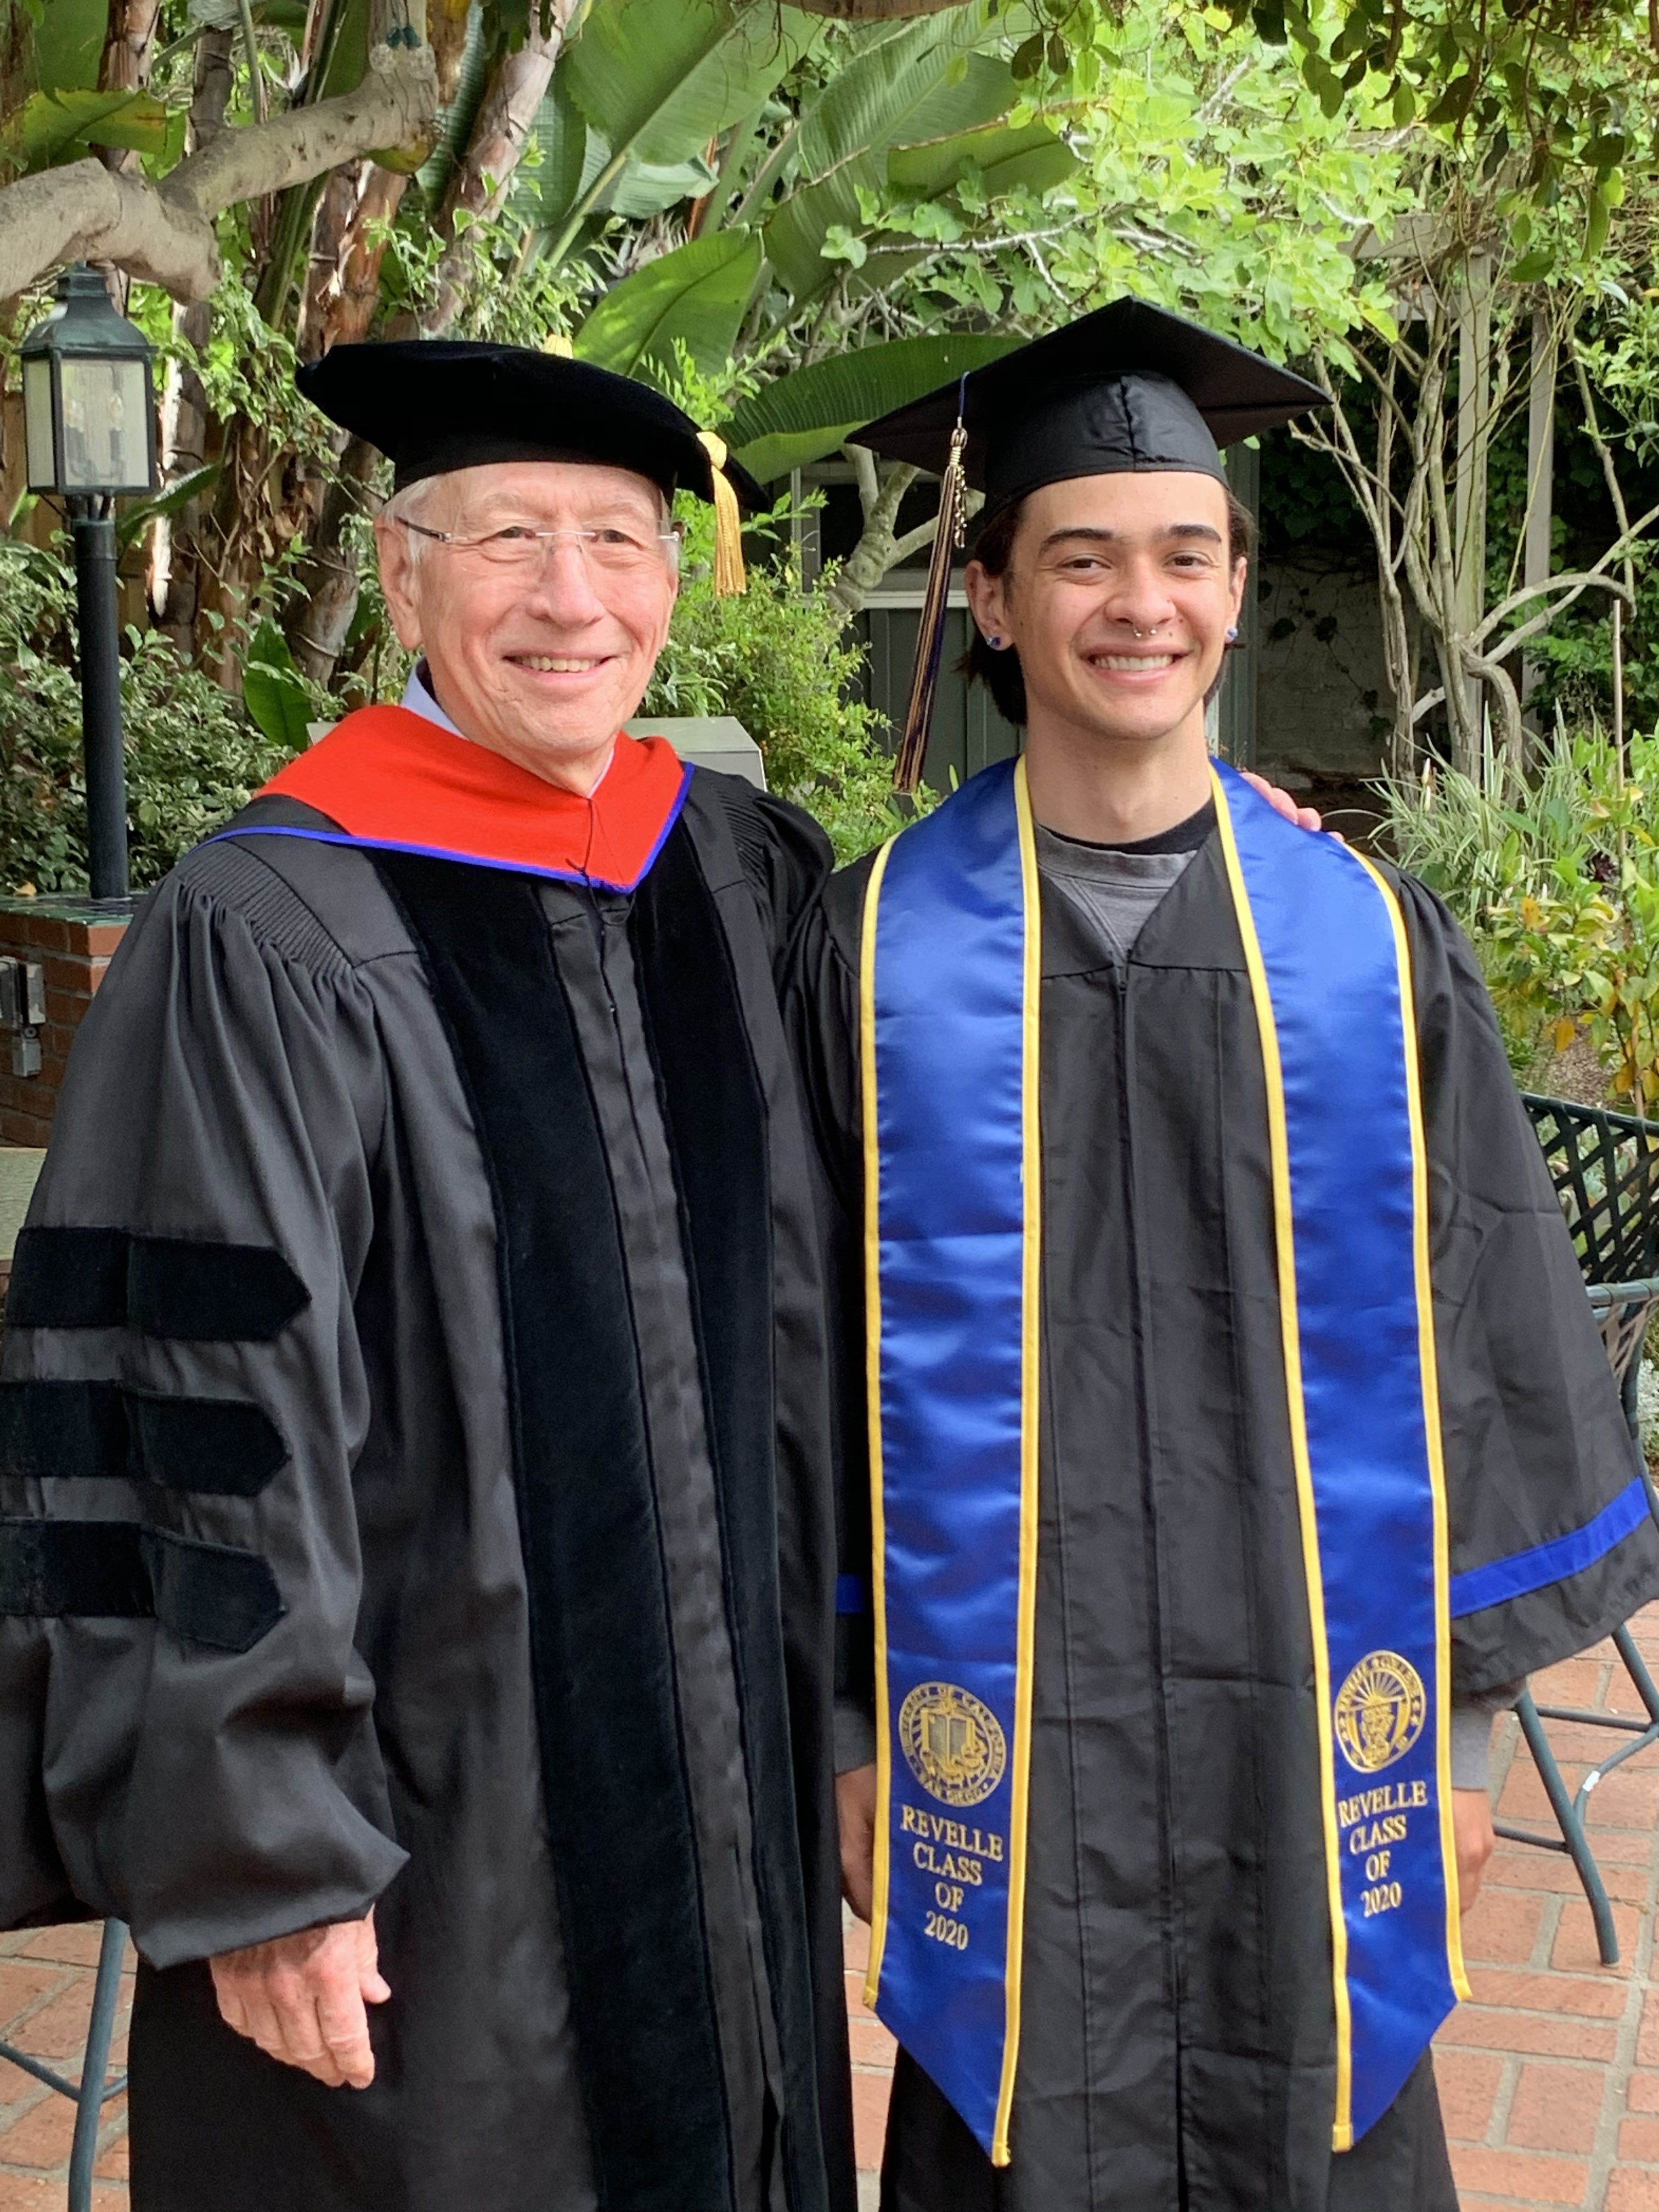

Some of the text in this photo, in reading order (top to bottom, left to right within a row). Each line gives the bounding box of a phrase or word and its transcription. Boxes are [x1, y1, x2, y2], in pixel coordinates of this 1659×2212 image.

[1339, 1780, 1427, 1828] REVELLE
[901, 1804, 1003, 1861] REVELLE
[1350, 1814, 1407, 1855] CLASS
[913, 1841, 982, 1885] CLASS
[1365, 1849, 1391, 1881] OF
[935, 1881, 964, 1911] OF
[1361, 1882, 1402, 1918] 2020
[925, 1911, 969, 1950] 2020
